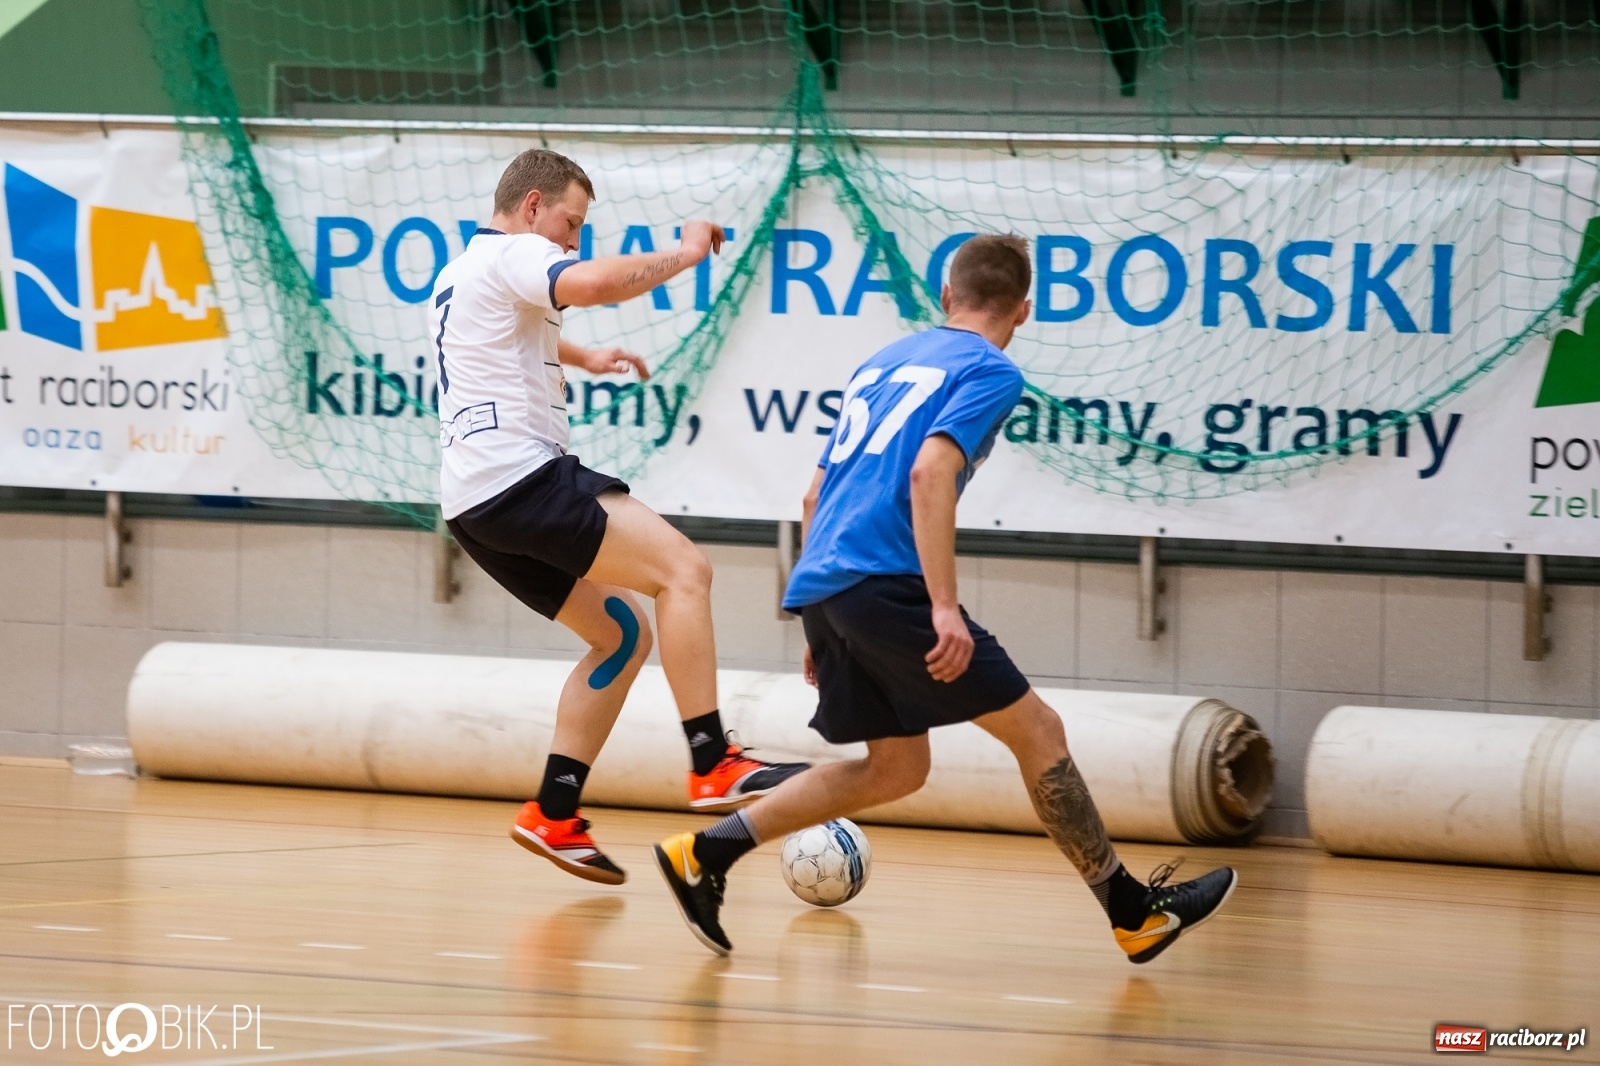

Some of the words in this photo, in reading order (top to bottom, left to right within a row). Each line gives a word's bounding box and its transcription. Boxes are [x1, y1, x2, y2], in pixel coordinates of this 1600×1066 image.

[314, 215, 735, 312] POAT
[770, 228, 1454, 335] RACBORSKI
[39, 366, 230, 412] raciborski
[304, 351, 701, 447] kibimy,
[744, 388, 1173, 465] wsamy,
[1200, 399, 1463, 479] gramy
[828, 365, 947, 464] 67
[22, 427, 102, 451] oaza
[128, 424, 225, 455] kultur
